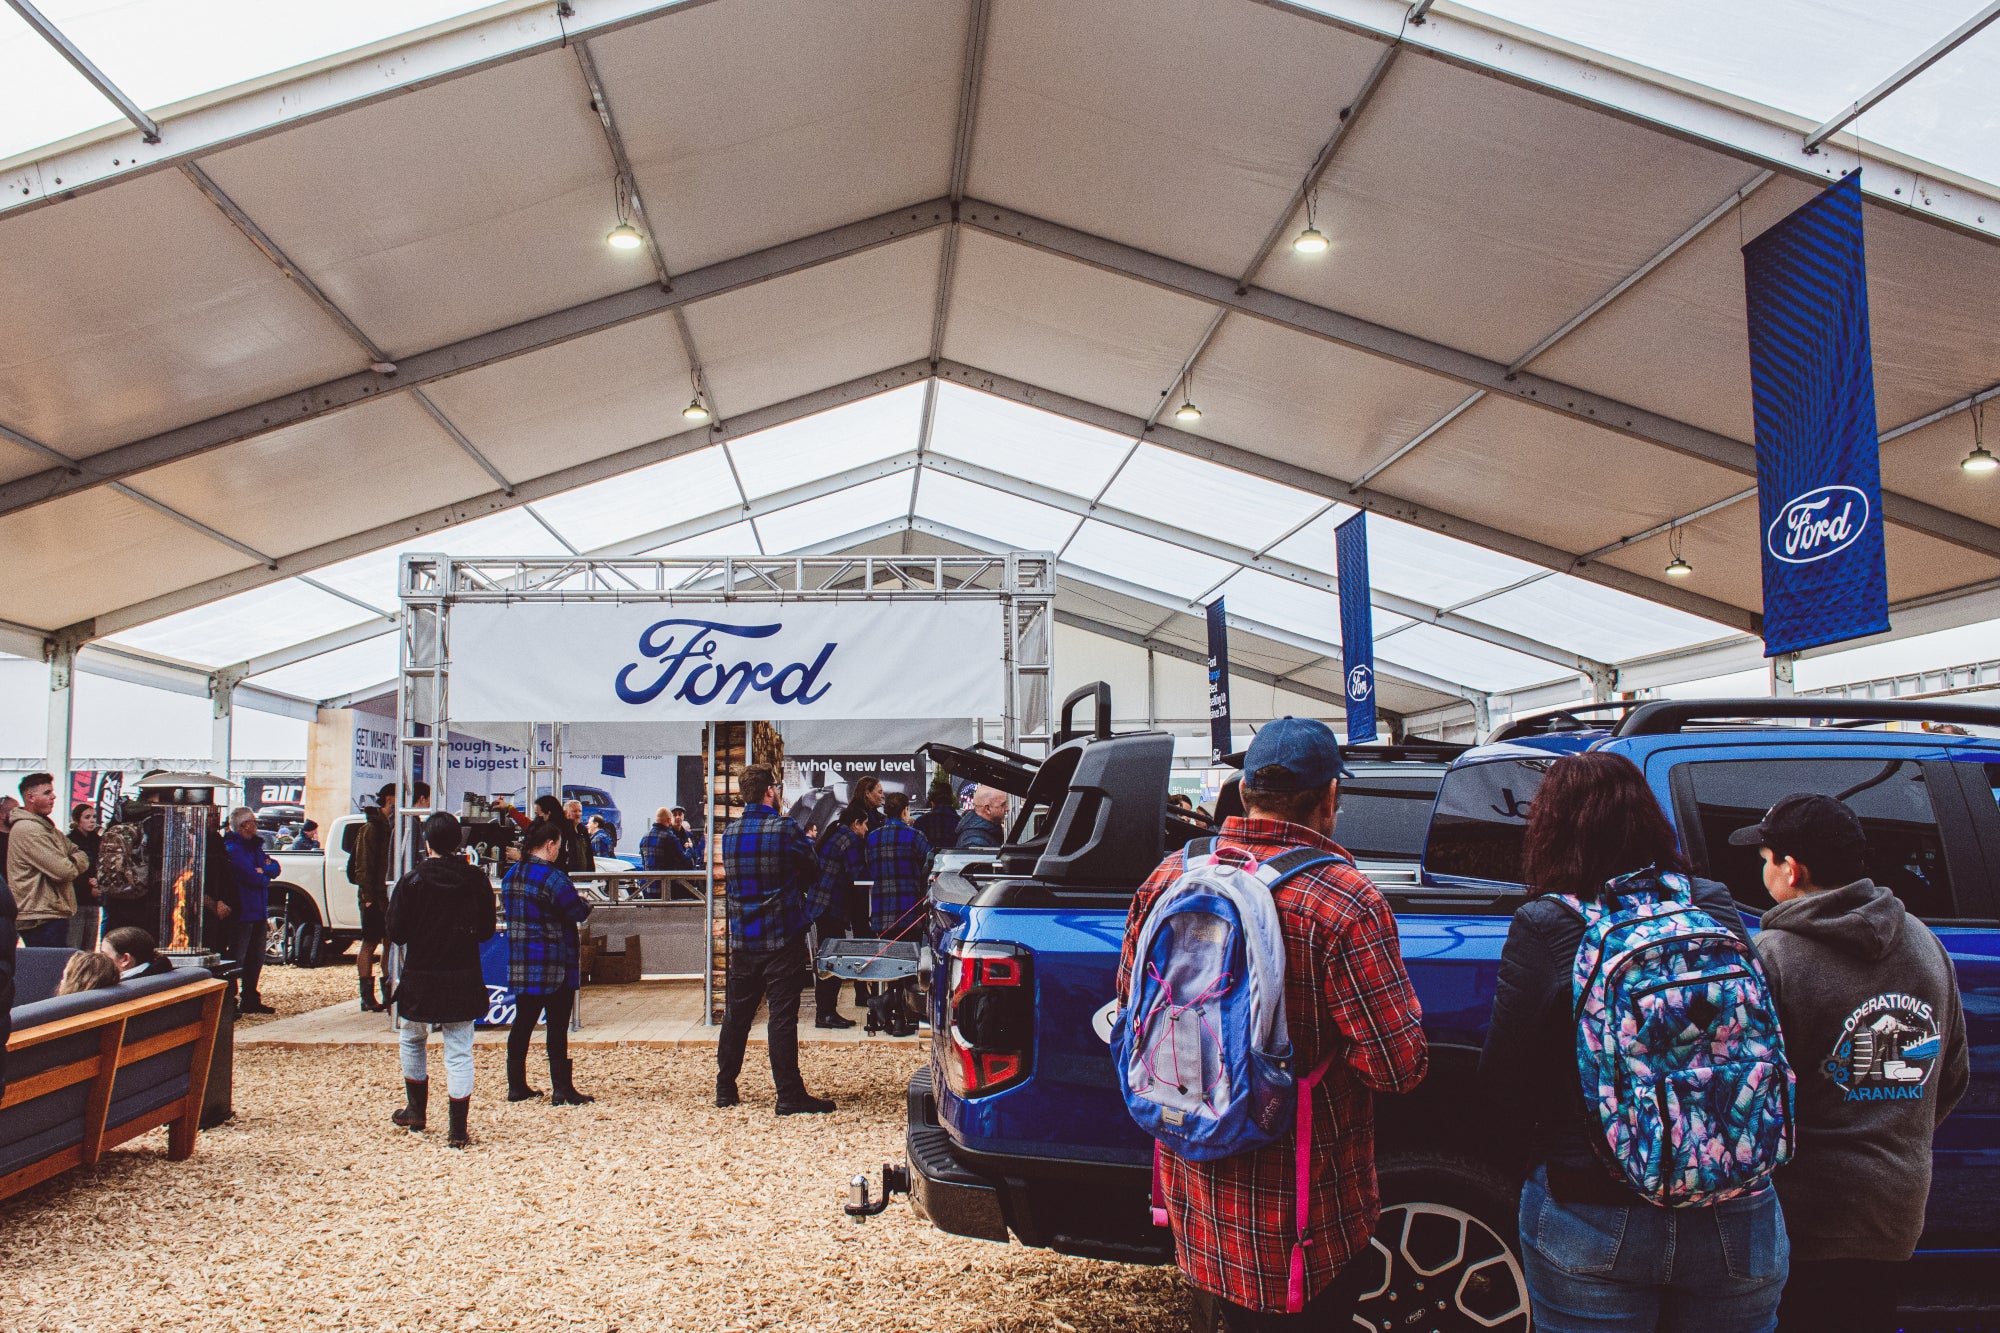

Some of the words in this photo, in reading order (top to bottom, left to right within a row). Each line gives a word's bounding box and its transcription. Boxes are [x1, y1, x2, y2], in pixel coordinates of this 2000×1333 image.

[1785, 496, 1852, 555] Ford
[615, 618, 838, 705] Ford
[356, 728, 369, 746] GET
[370, 730, 390, 749] WHAT
[438, 739, 491, 754] nough
[355, 749, 379, 768] REALLY
[465, 756, 519, 772] biggest
[797, 758, 842, 772] whole
[846, 760, 876, 772] new
[880, 758, 915, 772] level
[1844, 993, 1932, 1032] OPERATIONS
